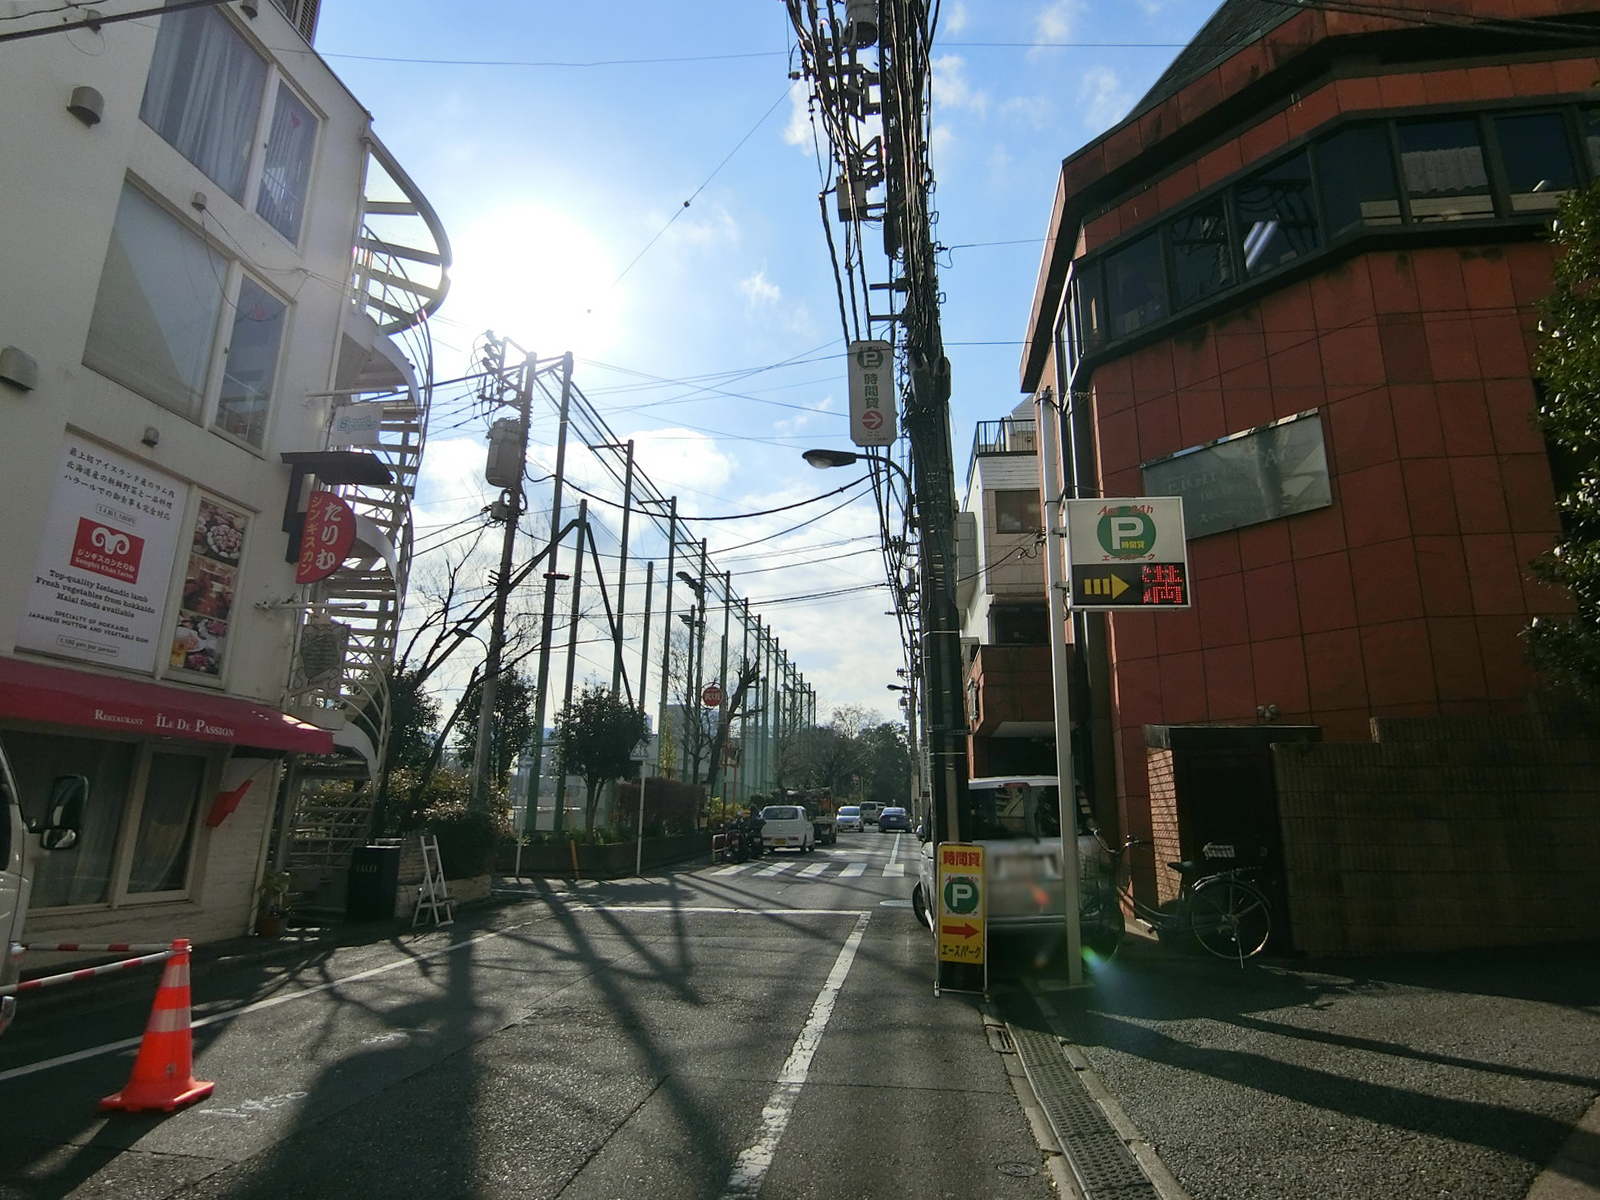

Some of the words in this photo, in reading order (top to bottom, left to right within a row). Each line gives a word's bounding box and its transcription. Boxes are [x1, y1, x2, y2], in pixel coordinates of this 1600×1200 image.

[864, 373, 879, 409] 時間貸
[316, 501, 343, 570] たりむ
[1110, 517, 1144, 550] P
[1121, 540, 1145, 549] 時間貸
[100, 564, 116, 573] Khan
[35, 576, 60, 588] Fresh
[61, 584, 103, 600] vegetables
[103, 595, 122, 604] from
[49, 569, 95, 588] Top-quality
[95, 582, 130, 597] Icelandic
[130, 592, 149, 602] lamb
[56, 592, 79, 603] Halal
[79, 598, 101, 609] foods
[101, 604, 135, 618] available
[27, 611, 59, 623] JAPANESE
[61, 619, 87, 629] MUTTON
[89, 625, 102, 633] AND
[104, 629, 134, 640] VEGETABLE
[54, 610, 86, 622] SPECIALTY
[98, 621, 128, 632] HOKKAIDO
[943, 851, 980, 867] 時間貸
[952, 883, 972, 907] P
[942, 944, 981, 958] エースパーク
